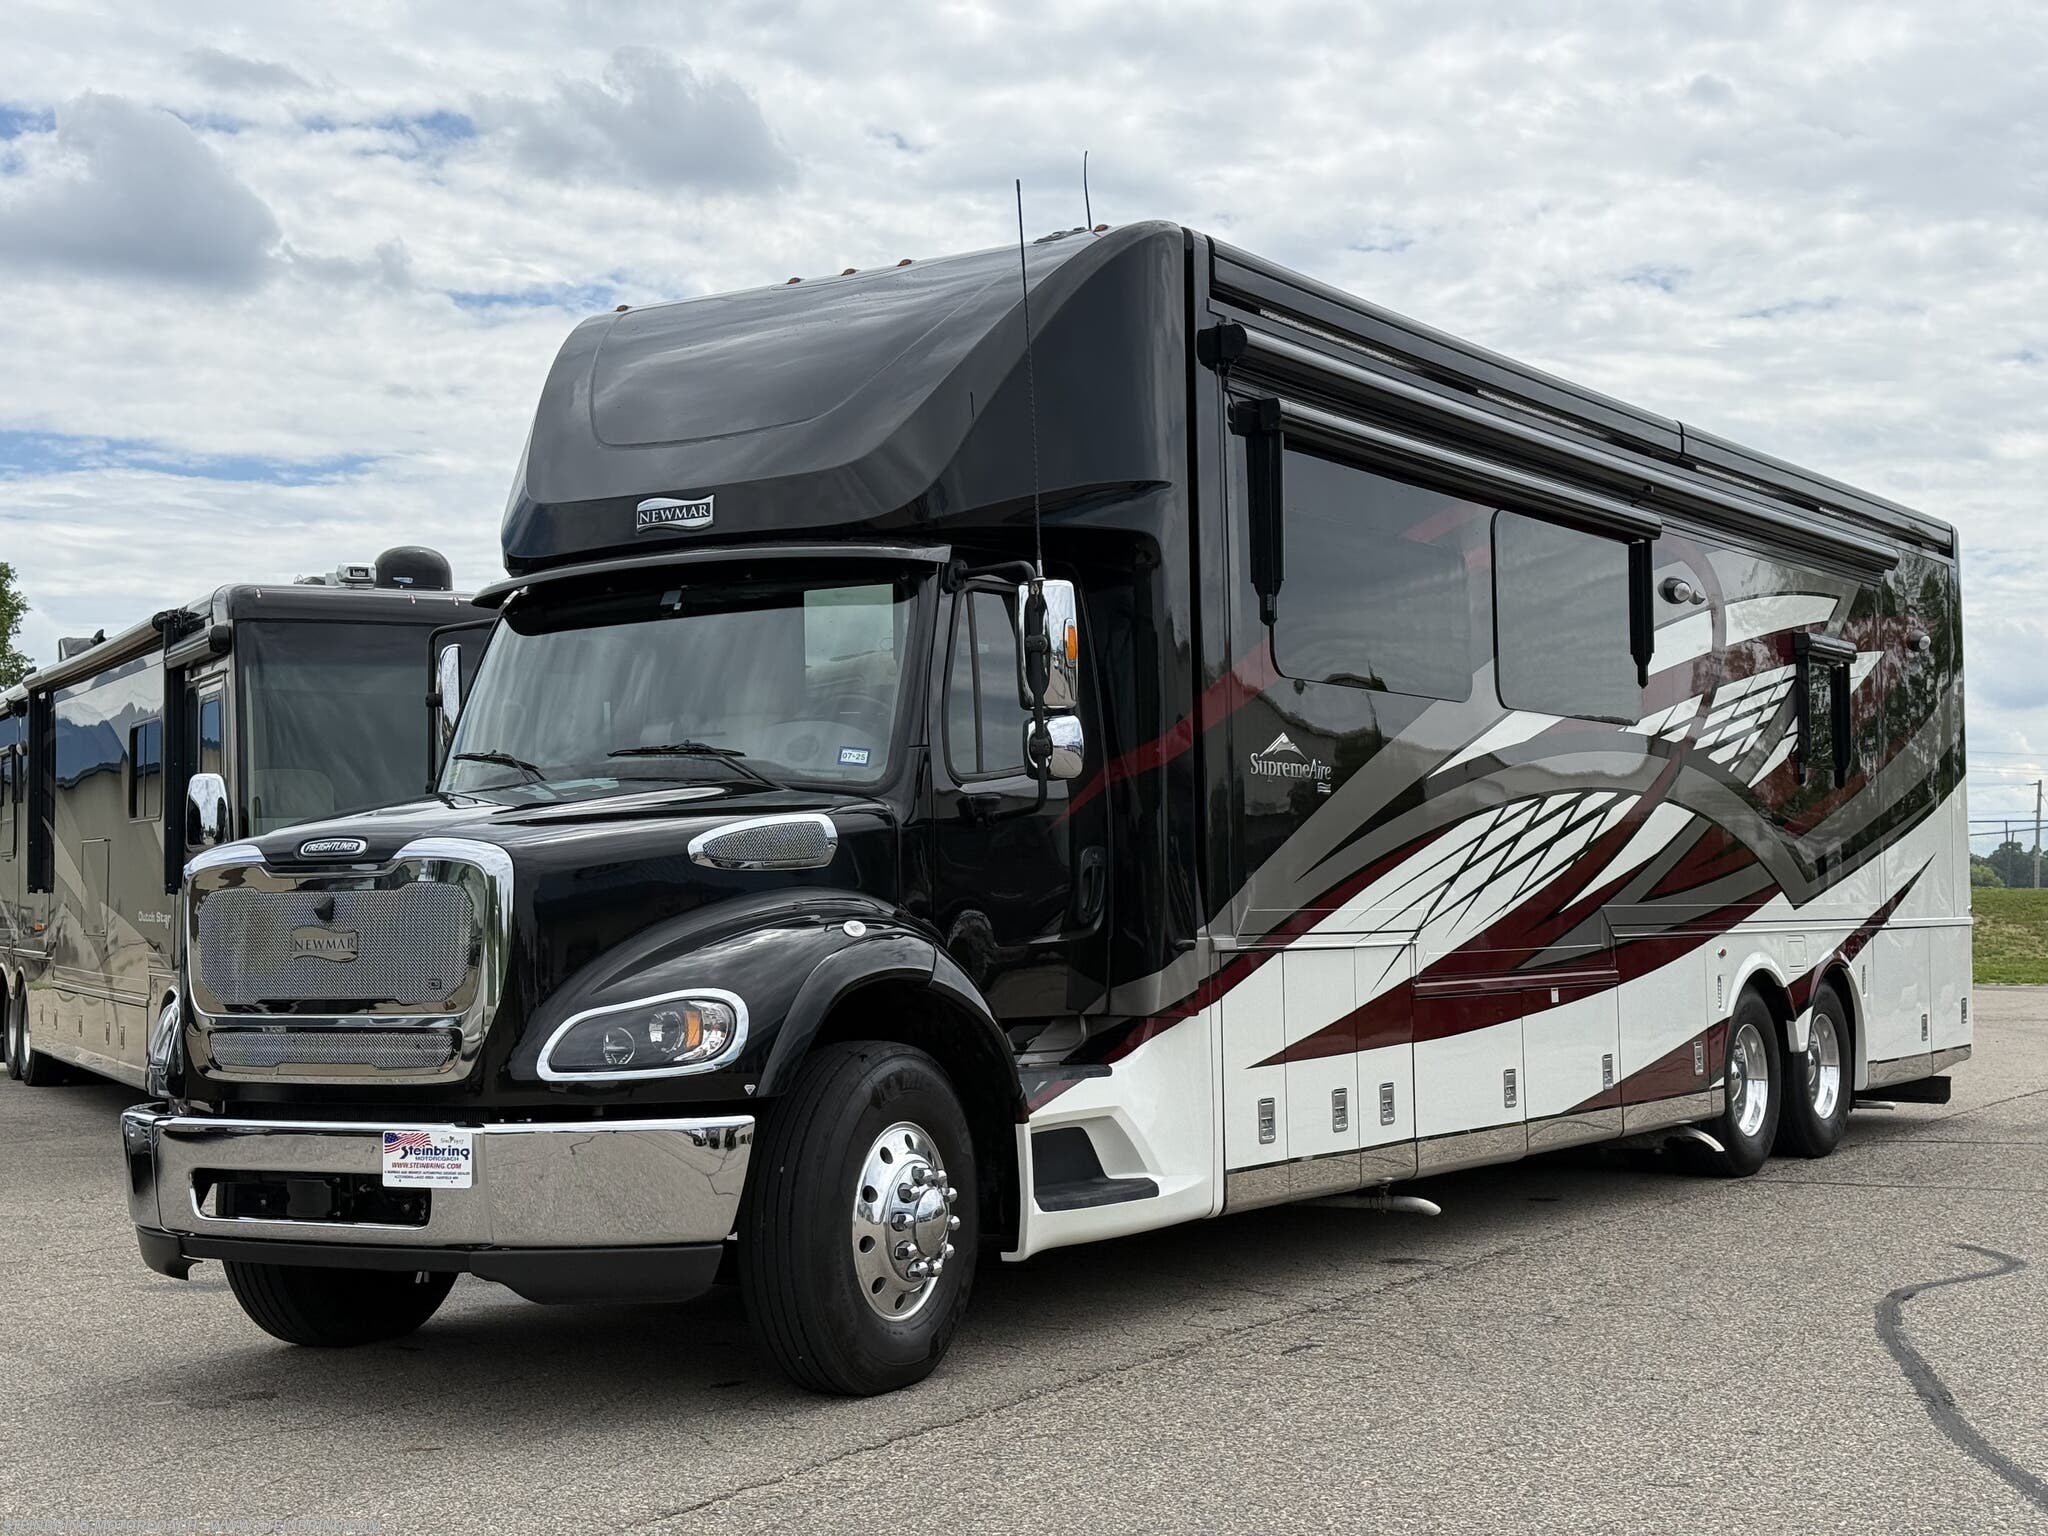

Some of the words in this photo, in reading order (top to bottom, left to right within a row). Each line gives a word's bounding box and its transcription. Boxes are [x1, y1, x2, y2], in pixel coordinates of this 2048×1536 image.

[639, 504, 710, 524] NEWMAR
[1250, 752, 1332, 783] SupremeAire
[305, 841, 359, 852] FREIGHTLINER
[294, 939, 355, 951] NEWMAR
[400, 1145, 470, 1160] Steinbring
